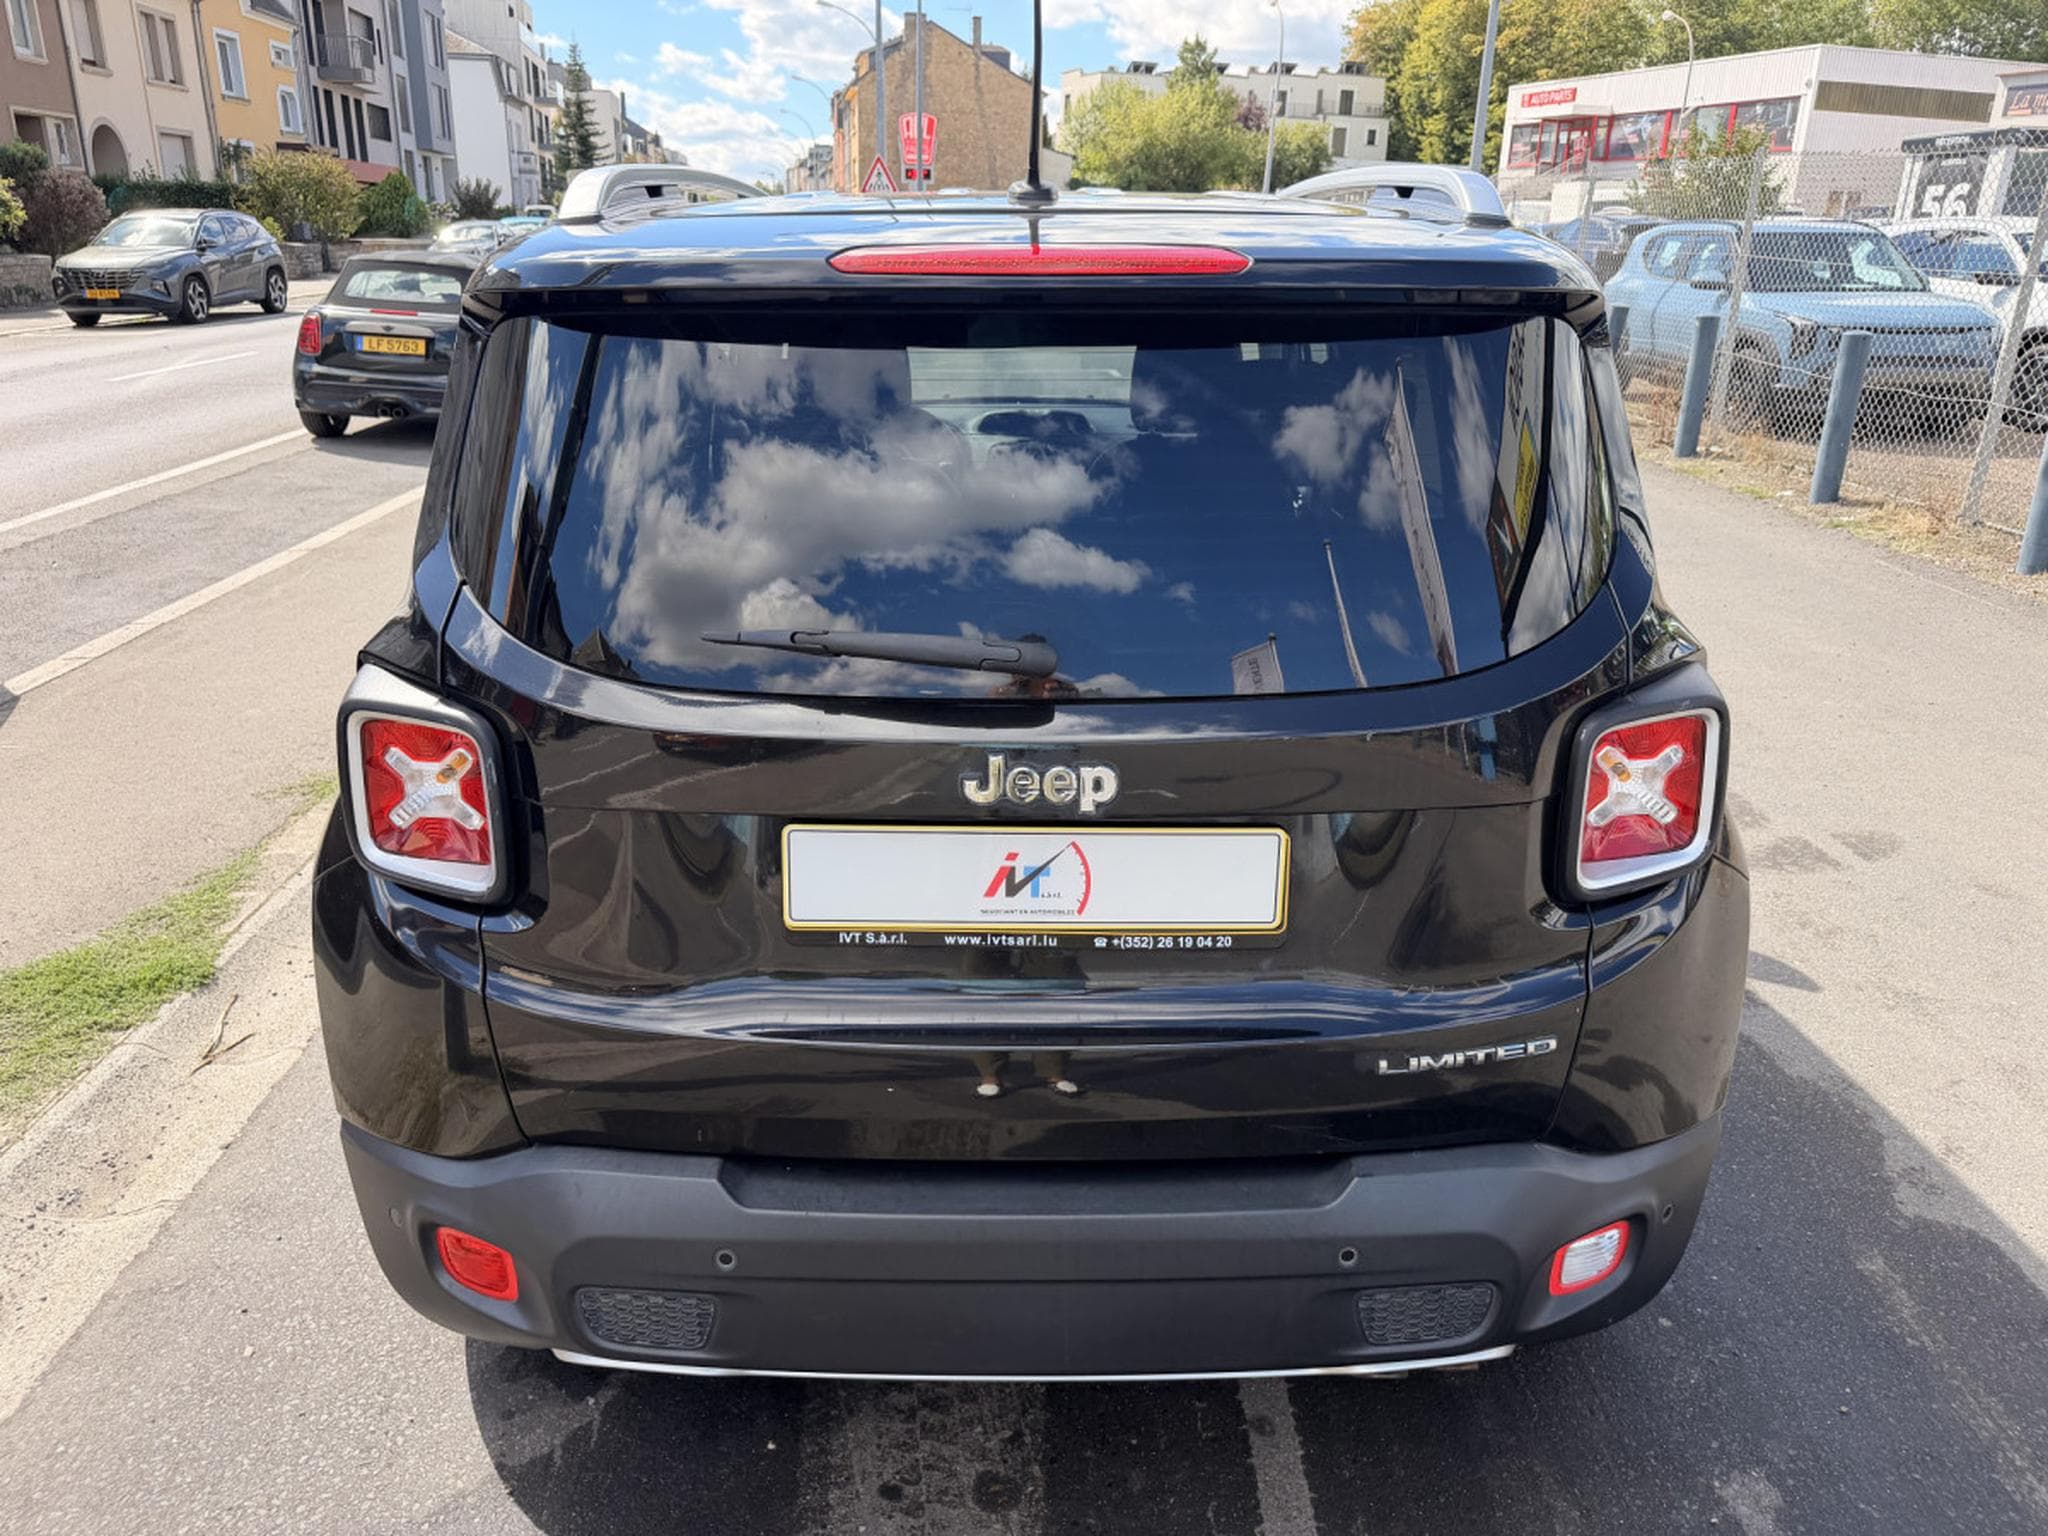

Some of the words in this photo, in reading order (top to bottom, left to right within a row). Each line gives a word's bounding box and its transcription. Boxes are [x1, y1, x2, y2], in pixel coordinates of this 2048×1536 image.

[1921, 182, 1970, 216] 56
[368, 338, 385, 350] LF
[386, 339, 419, 353] 5763
[963, 754, 1118, 812] Jeep
[838, 932, 861, 944] IVT
[944, 934, 1058, 946] www.ivtsarl.lu
[1156, 936, 1173, 948] 26
[1178, 936, 1193, 948] 19
[1196, 936, 1212, 948] 04
[1216, 936, 1232, 948] 20
[1378, 1036, 1557, 1075] LIMITED
